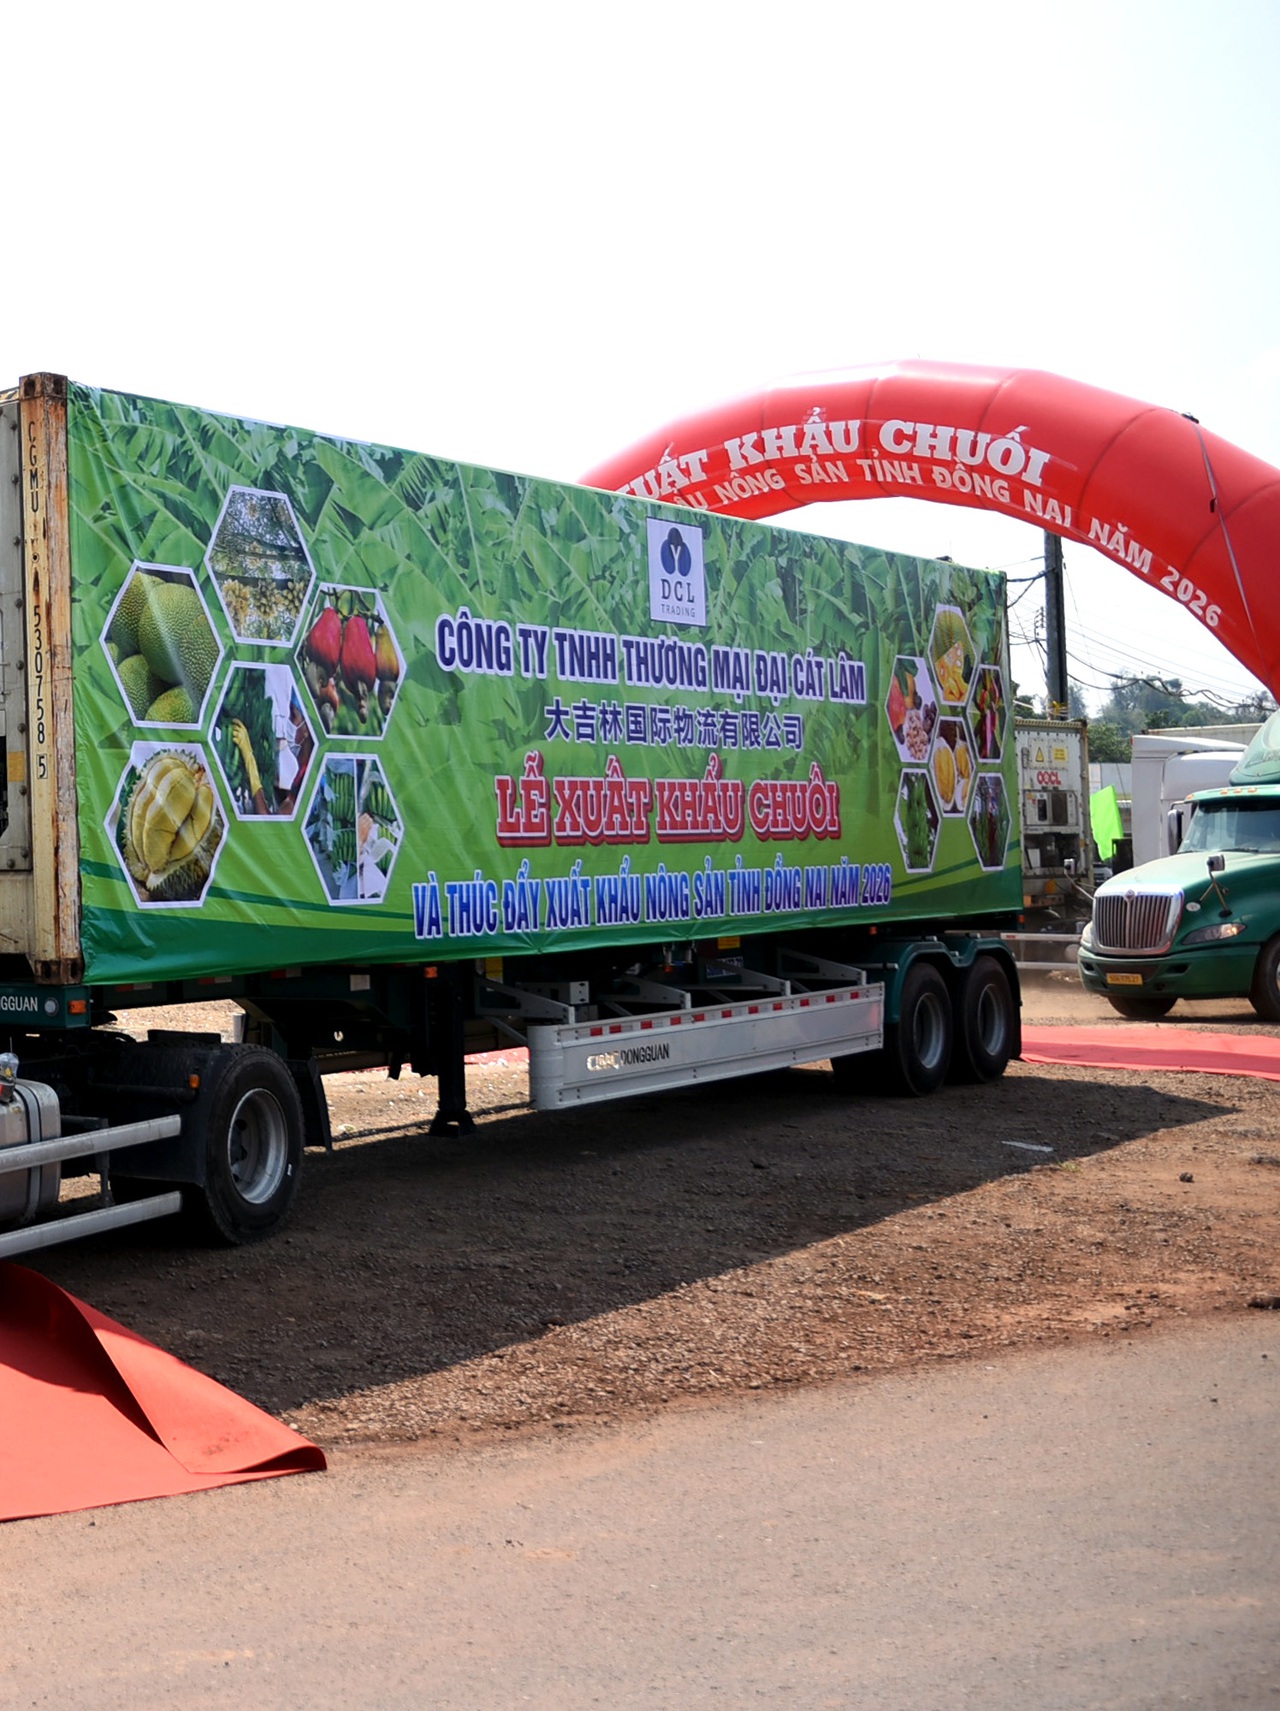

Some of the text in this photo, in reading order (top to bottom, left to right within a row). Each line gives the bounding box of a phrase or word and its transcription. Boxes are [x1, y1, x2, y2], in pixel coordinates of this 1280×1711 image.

[28, 421, 39, 513] CGMU
[724, 406, 861, 471] KHẨU
[878, 419, 1051, 487] CHUỐI
[713, 469, 786, 505] NÔNG
[791, 450, 849, 485] SẢN
[856, 448, 924, 485] TỈNH
[932, 456, 1011, 504] ĐỒNG
[1022, 489, 1072, 528] NAI
[1088, 517, 1153, 574] NĂM
[1160, 565, 1222, 628] 2026
[661, 578, 695, 604] DCL
[661, 604, 696, 618] TRADING
[33, 605, 45, 745] 530758
[436, 609, 866, 703] CÔNG TY TNHH THƯƠNG MẠI ĐẠI CÁT LÂM
[546, 699, 803, 749] 大吉林国际物流有限公司
[495, 751, 839, 842] LỄ XUẤT KHẨU CHUỐI
[413, 853, 892, 938] VÀ THÚC ĐẨY XUẤT KHẨU NÔNG SẢN TỈNH ĐỒNG NAI NĂM 2026
[620, 1043, 670, 1065] DONGGUAN
